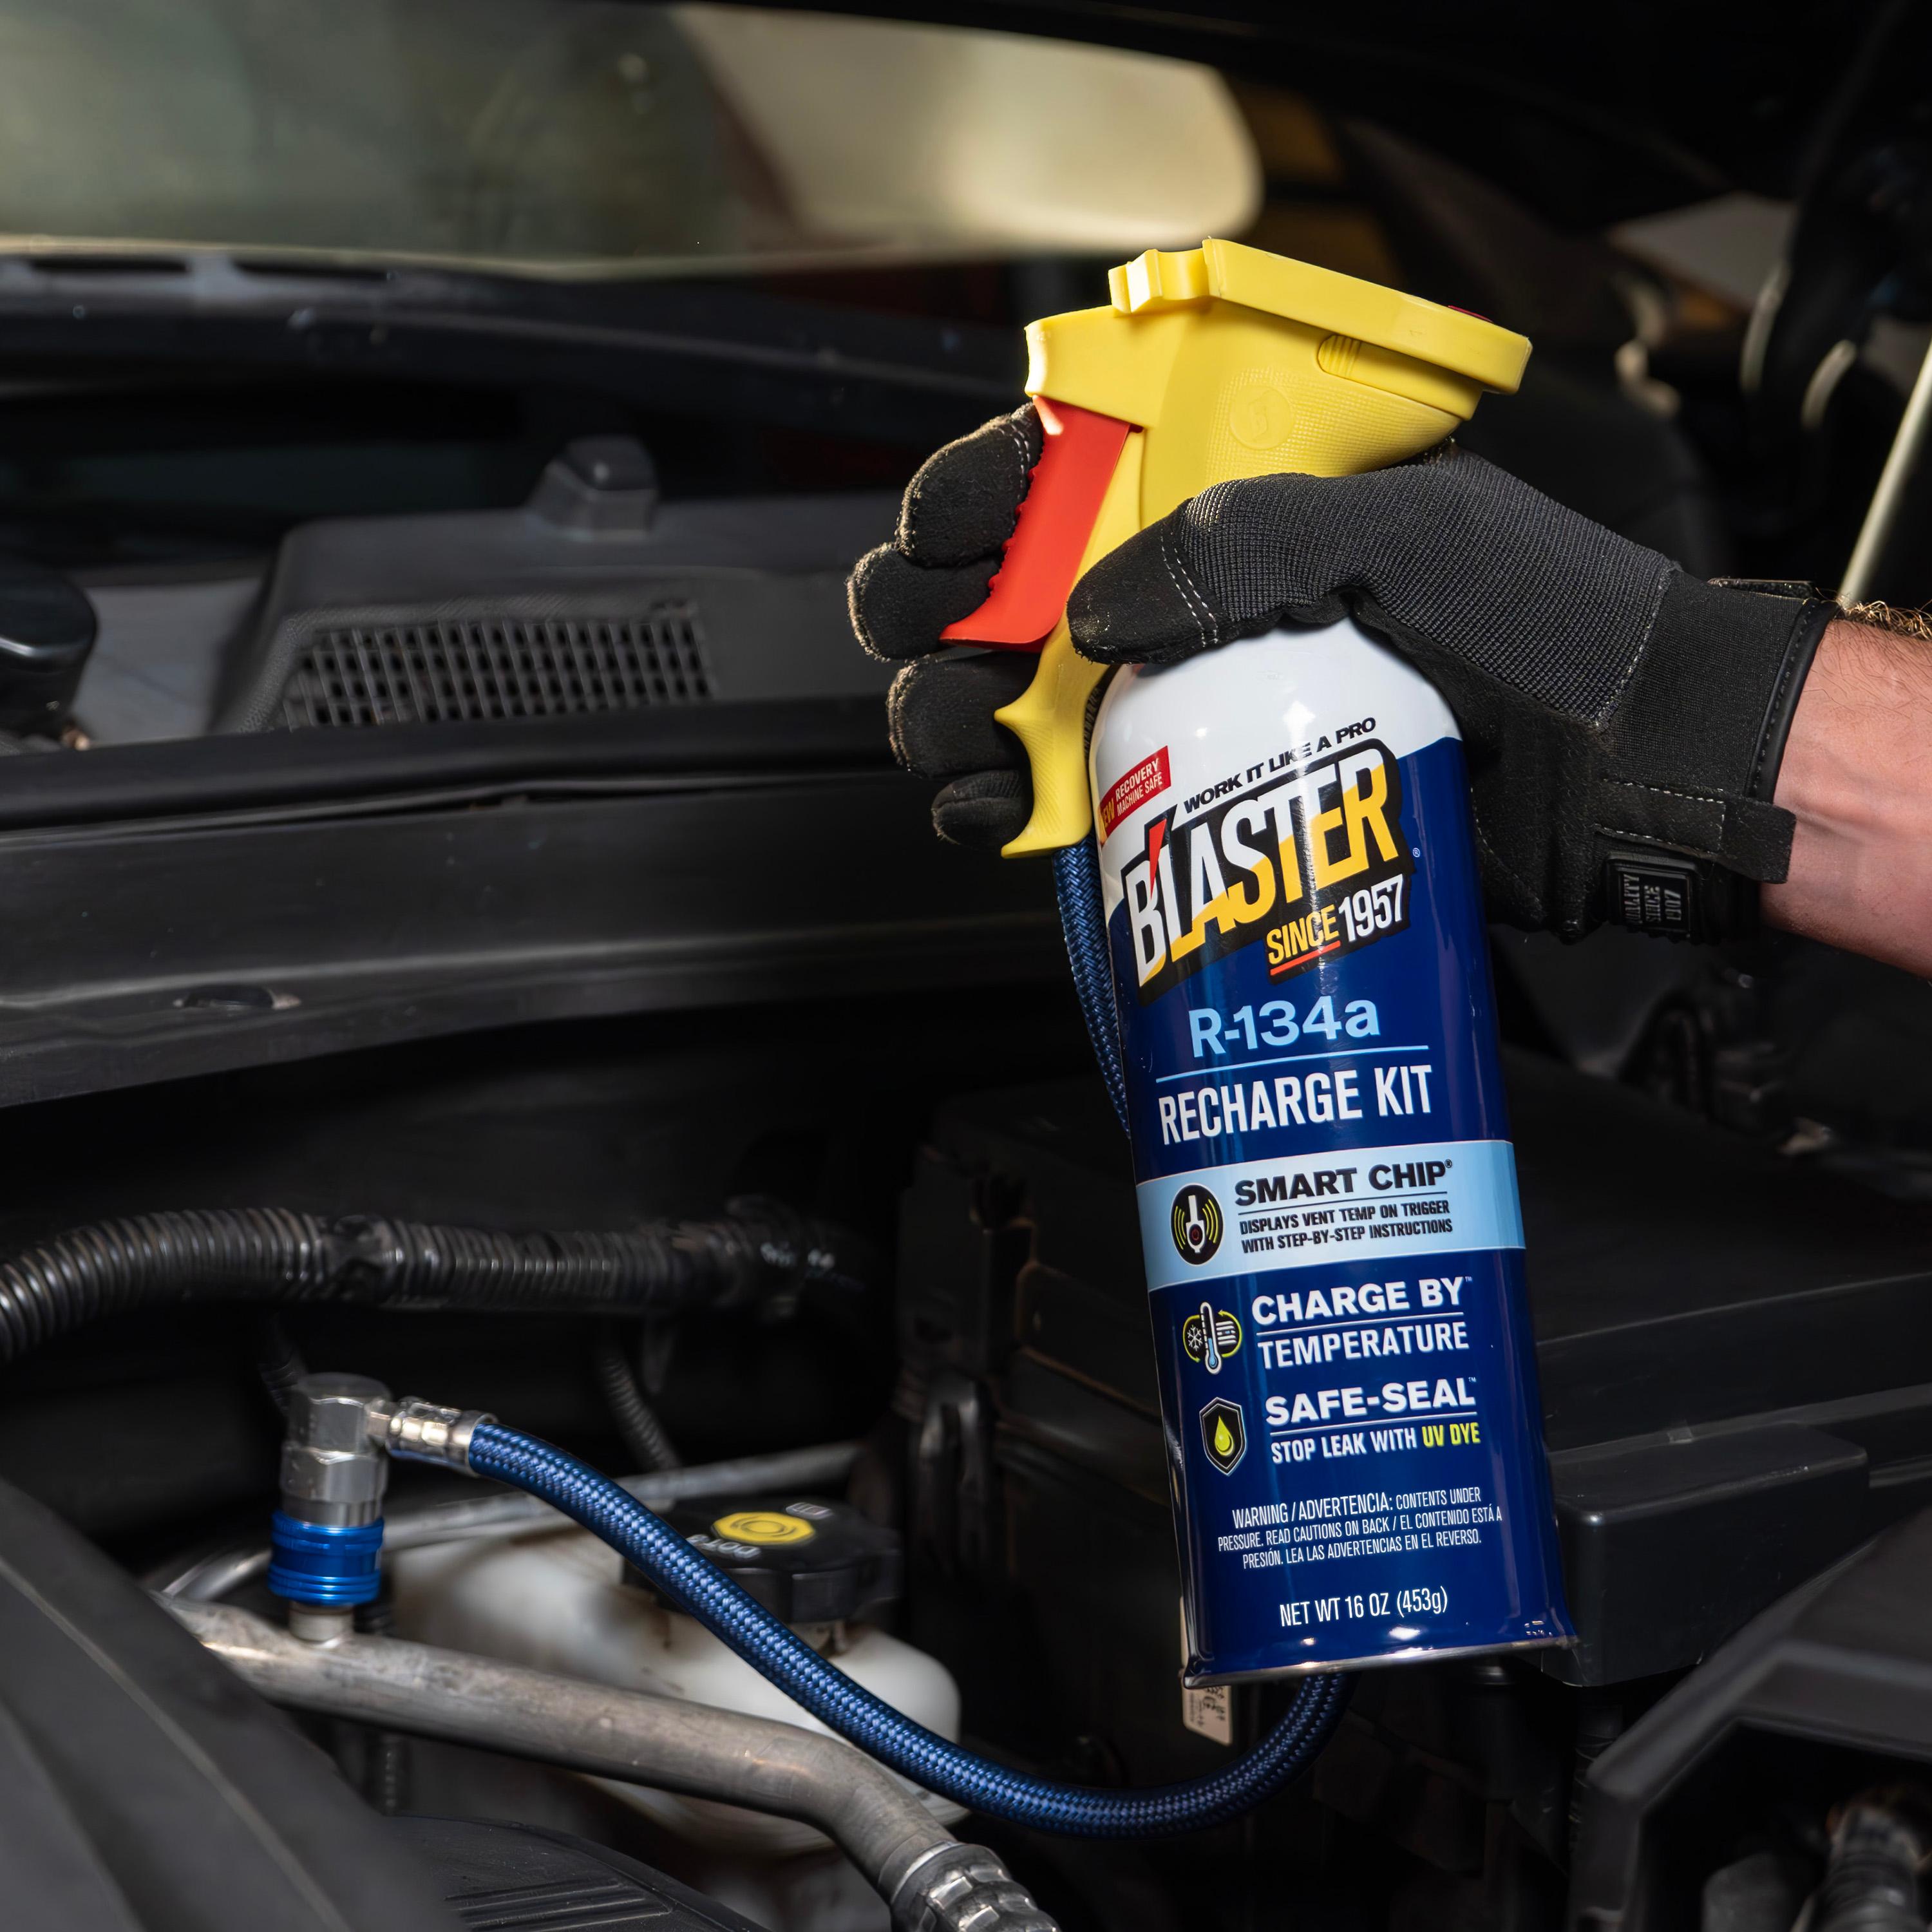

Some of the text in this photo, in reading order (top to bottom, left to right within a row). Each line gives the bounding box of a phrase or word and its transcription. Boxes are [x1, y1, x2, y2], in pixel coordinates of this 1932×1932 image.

[1115, 758, 1159, 802] RECOVERY
[1184, 717, 1376, 813] WORK IT LIKE A PRO
[1101, 798, 1115, 829] EW
[1117, 772, 1162, 817] MACHINE SAFE
[1266, 873, 1405, 965] SINCE 1957
[1189, 996, 1381, 1057] R-134a
[1159, 1065, 1432, 1145] RECHARGE KIT
[1235, 1168, 1357, 1206] SMART
[1239, 1200, 1450, 1235] DISPLAYS VENT TEMP ON TRIGGER
[1242, 1218, 1453, 1253] WITH STEP-BY-STEP INSTRUCTIONS
[1252, 1281, 1410, 1325] CHARGE
[1257, 1322, 1470, 1370] TEMPERATURE
[1271, 1422, 1481, 1464] STOP LEAK WITH UV DYE
[1218, 1503, 1502, 1552] PRESSURE. READ CAUTIONS ON BACK / EL CONTENIDO ESTÁ A
[1232, 1502, 1288, 1529] WARNING
[1396, 1490, 1447, 1510] CONTENTS
[1450, 1487, 1481, 1504] UNDER
[1243, 1528, 1482, 1569] PRESIÓN. LEA LAS ADVERTENCIAS EN EL REVERSO.
[1279, 1586, 1449, 1627] NET WT 16 OZ (453g)
